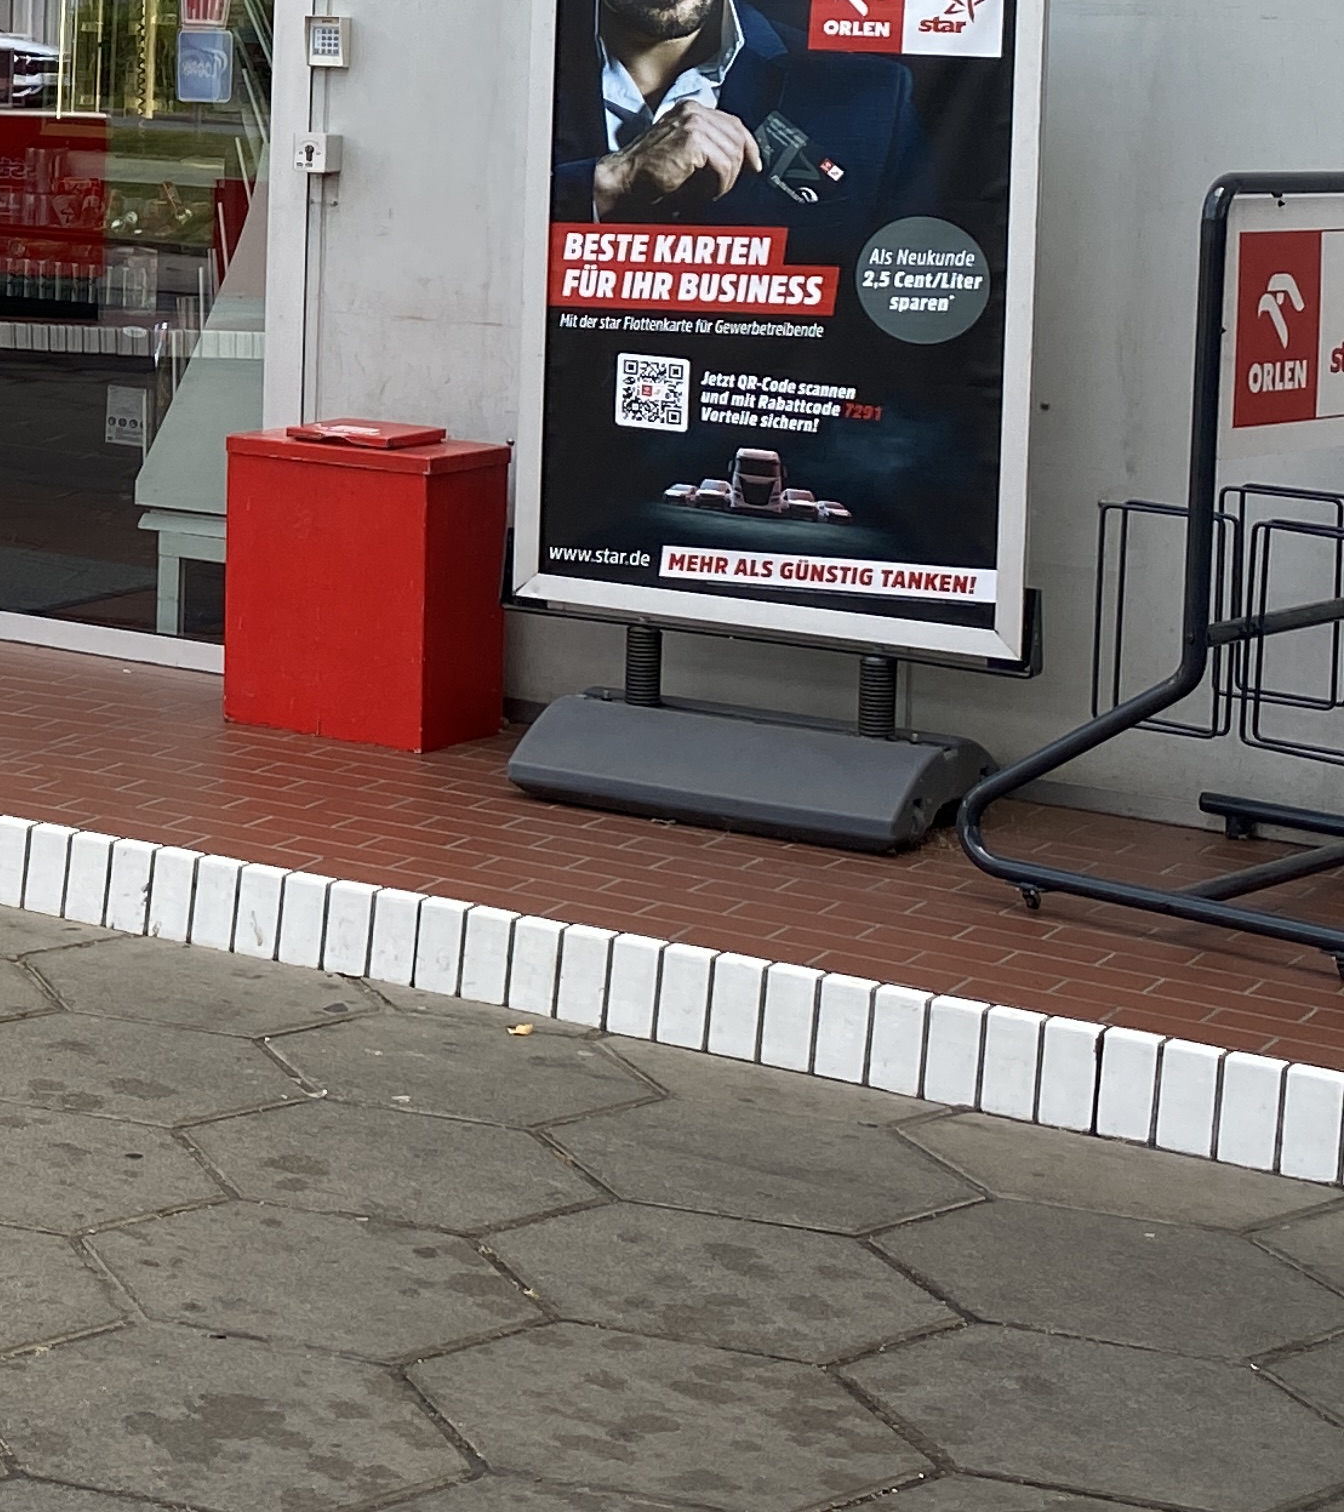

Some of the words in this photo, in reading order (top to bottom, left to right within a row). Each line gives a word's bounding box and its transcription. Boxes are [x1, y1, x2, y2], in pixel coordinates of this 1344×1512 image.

[823, 19, 890, 37] ORLEN
[918, 16, 967, 34] star
[563, 232, 650, 262] BESTE
[653, 234, 772, 266] KARTEN
[869, 248, 893, 265] Als
[896, 248, 975, 267] Neukunde
[562, 264, 616, 298] FÜR
[621, 271, 674, 301] IHR
[677, 273, 824, 305] BUSINESS
[862, 271, 891, 289] 2,5
[893, 271, 984, 290] Cent/Liter
[559, 313, 578, 328] Mit
[579, 315, 598, 329] der
[600, 317, 622, 330] star
[623, 317, 693, 334] Flottenkarte
[695, 319, 713, 334] für
[715, 319, 824, 338] Gewerbetreibende
[700, 371, 736, 388] Jetzt
[737, 375, 797, 394] QR-Code
[797, 382, 857, 400] scannen
[1248, 360, 1308, 394] ORLEN
[700, 390, 730, 405] und
[730, 392, 756, 408] mit
[757, 394, 841, 417] Rabattcode
[844, 402, 883, 421] 7291
[700, 406, 758, 427] Vorteile
[759, 413, 820, 433] sichern!
[549, 546, 651, 567] www.star.de
[667, 552, 729, 575] MEHR
[733, 558, 774, 578] ALS
[779, 559, 874, 586] GÜNSTIG
[881, 569, 978, 595] TANKEN!
